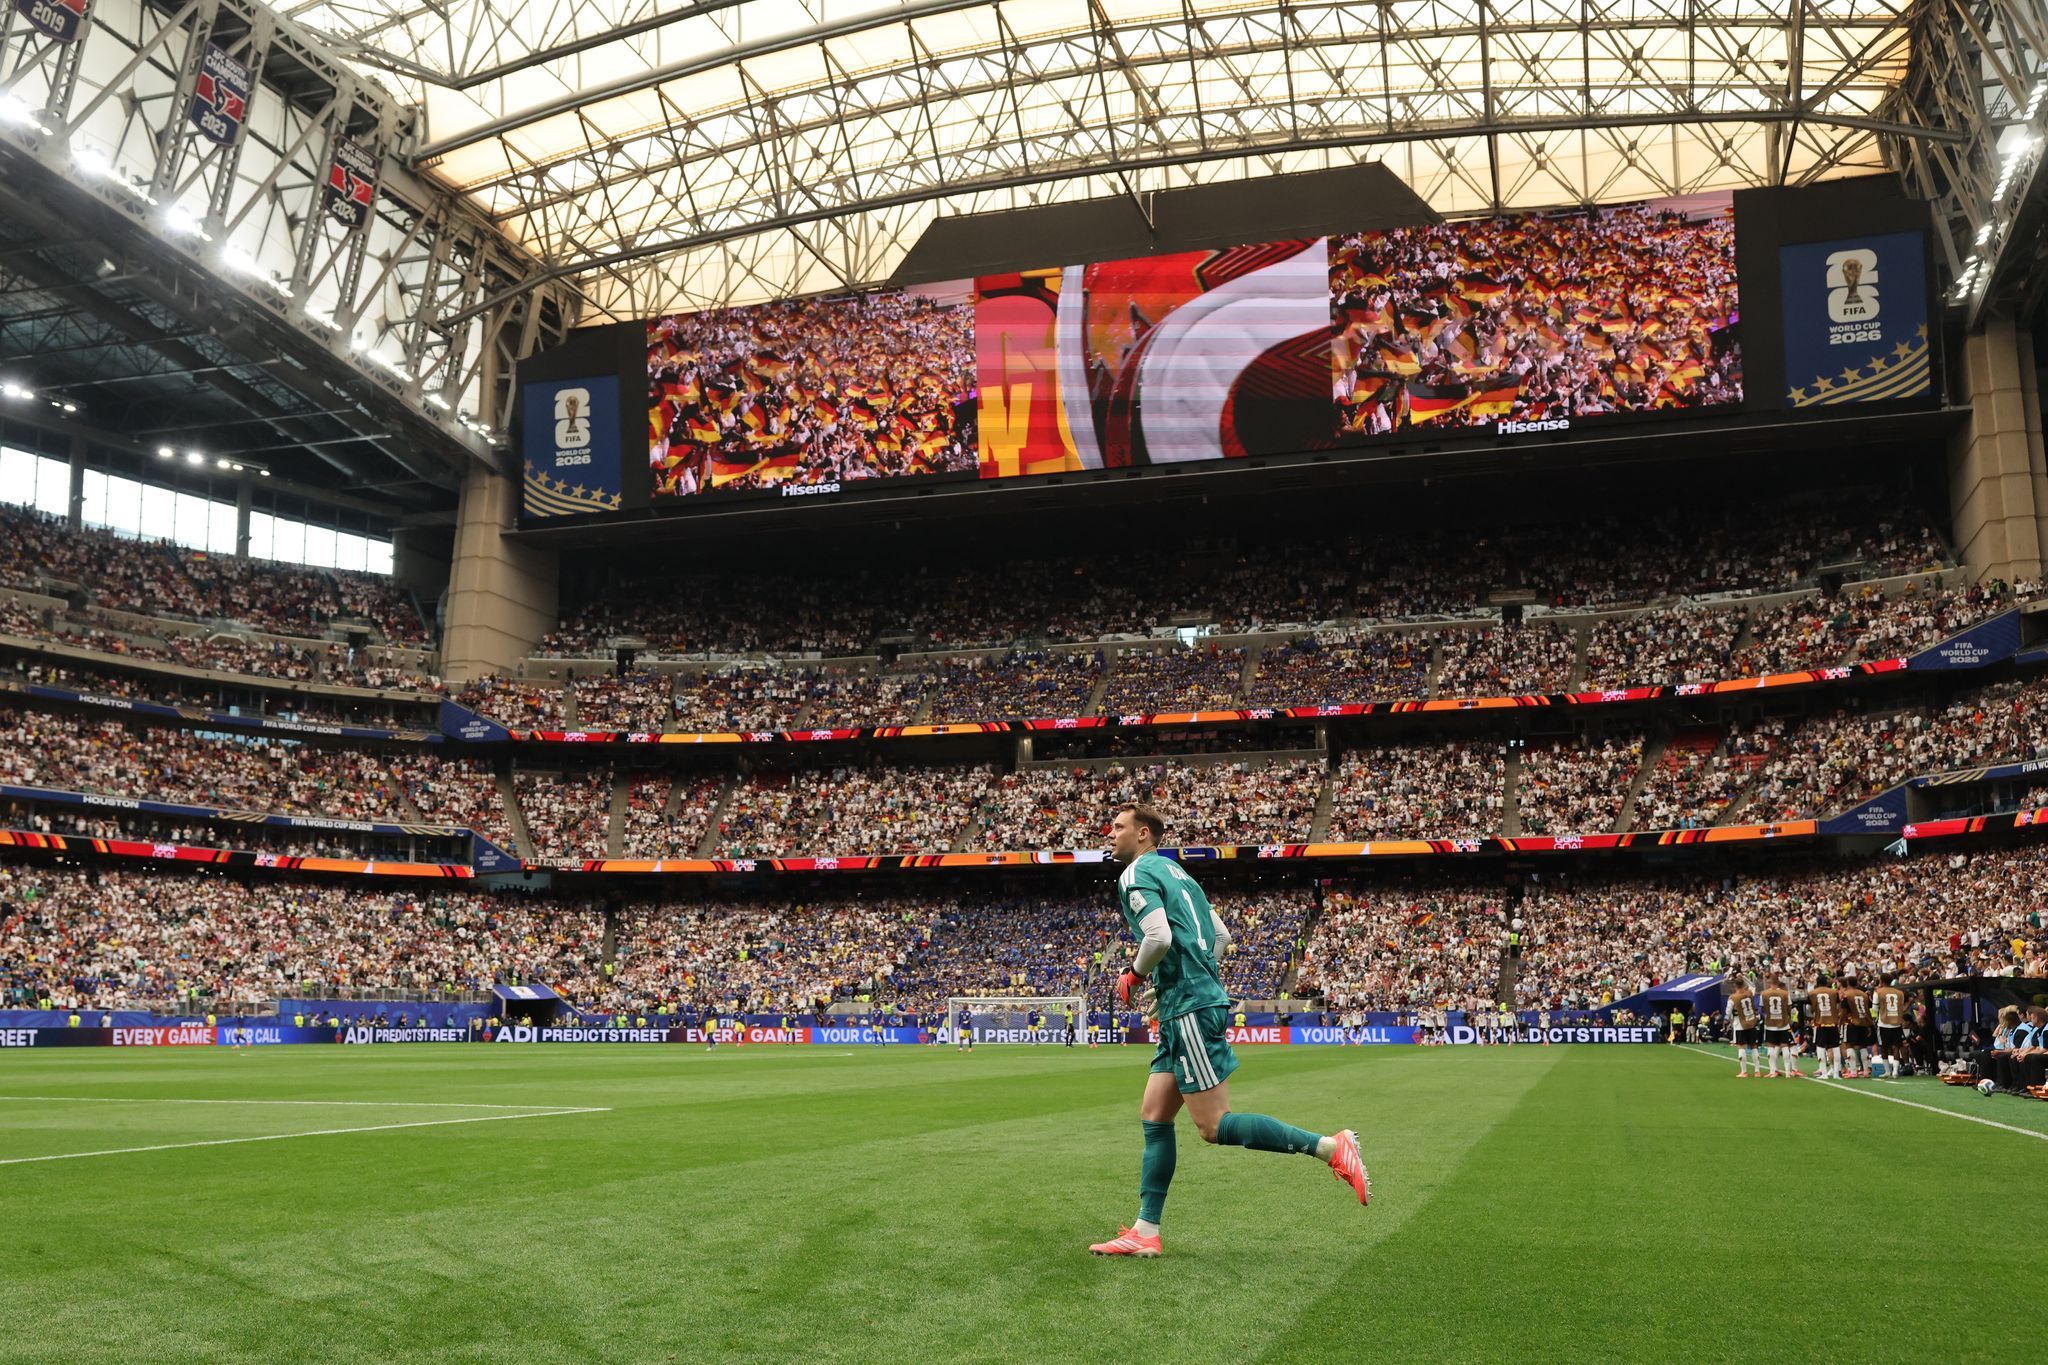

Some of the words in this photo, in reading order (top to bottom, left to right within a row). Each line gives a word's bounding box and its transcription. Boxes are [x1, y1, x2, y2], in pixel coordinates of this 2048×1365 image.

[30, 1, 65, 32] 2019
[205, 55, 248, 92] CHAMPIONS
[200, 111, 227, 139] 2023
[332, 198, 356, 223] 2024
[1843, 307, 1866, 316] FIFA
[1829, 324, 1861, 333] WORLD
[1863, 322, 1881, 330] CUP
[1829, 330, 1882, 345] 2026
[1497, 419, 1570, 435] Hisense
[565, 435, 581, 443] FIFA
[556, 455, 591, 467] 2026
[782, 483, 840, 497] Hisense
[1972, 648, 1989, 656] CUP
[1949, 656, 1979, 664] 2026
[79, 694, 132, 709] HOUSTON
[2022, 763, 2037, 772] FIFA
[83, 795, 139, 809] HOUSTON
[307, 820, 333, 828] WORLD
[1181, 888, 1208, 950] 1
[112, 1029, 165, 1045] EVERY
[172, 1029, 212, 1045] GAME
[255, 1028, 281, 1043] CALL
[344, 1027, 373, 1044] ADI
[375, 1029, 466, 1042] PREDICTSTREET
[495, 1026, 537, 1043] ADI
[542, 1029, 670, 1042] PREDICTSTREET
[821, 1029, 857, 1042] YOUR
[1225, 1028, 1281, 1043] GAME
[1301, 1029, 1343, 1042] YOUR
[1179, 1055, 1195, 1084] 1
